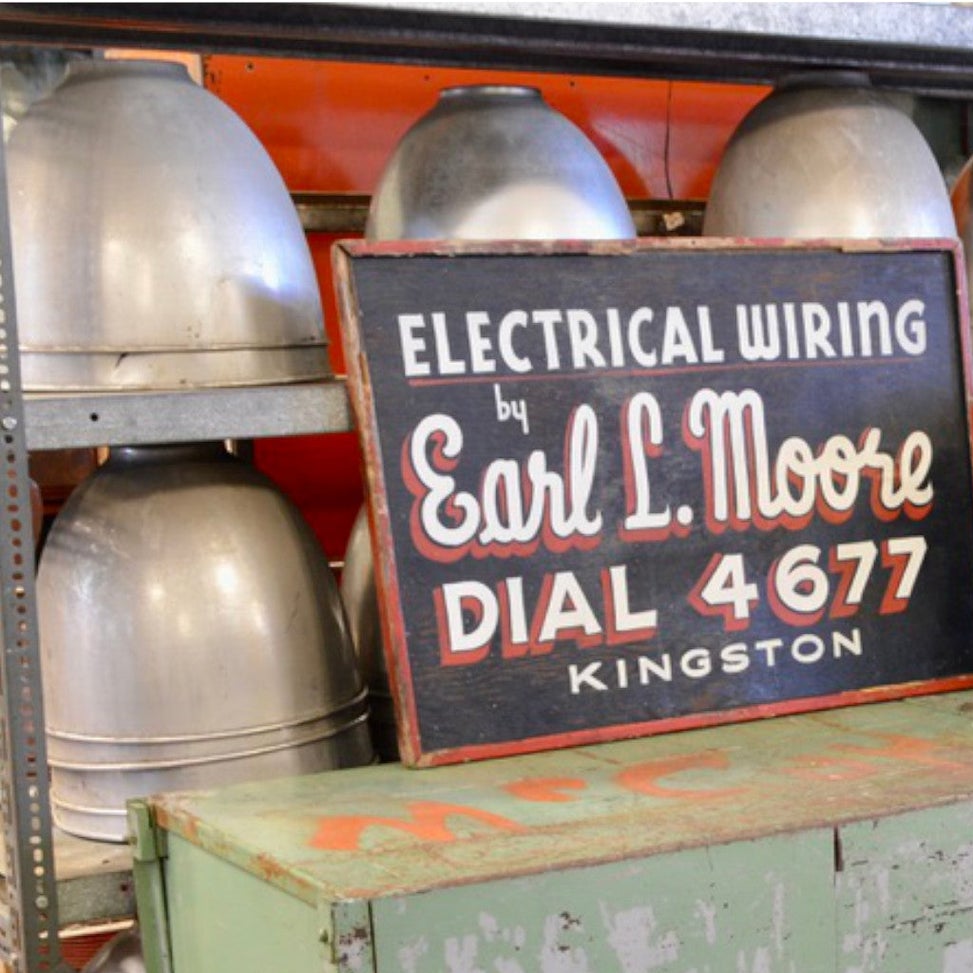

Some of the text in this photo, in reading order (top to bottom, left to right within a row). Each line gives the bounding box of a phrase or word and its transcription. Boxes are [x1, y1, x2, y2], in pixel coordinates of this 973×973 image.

[398, 299, 928, 376] ELECTRICAL WIRING
[494, 384, 530, 434] by
[404, 388, 935, 562] Earl L. Moore
[436, 535, 928, 666] DIAL 4677
[568, 629, 863, 695] KINGSTON
